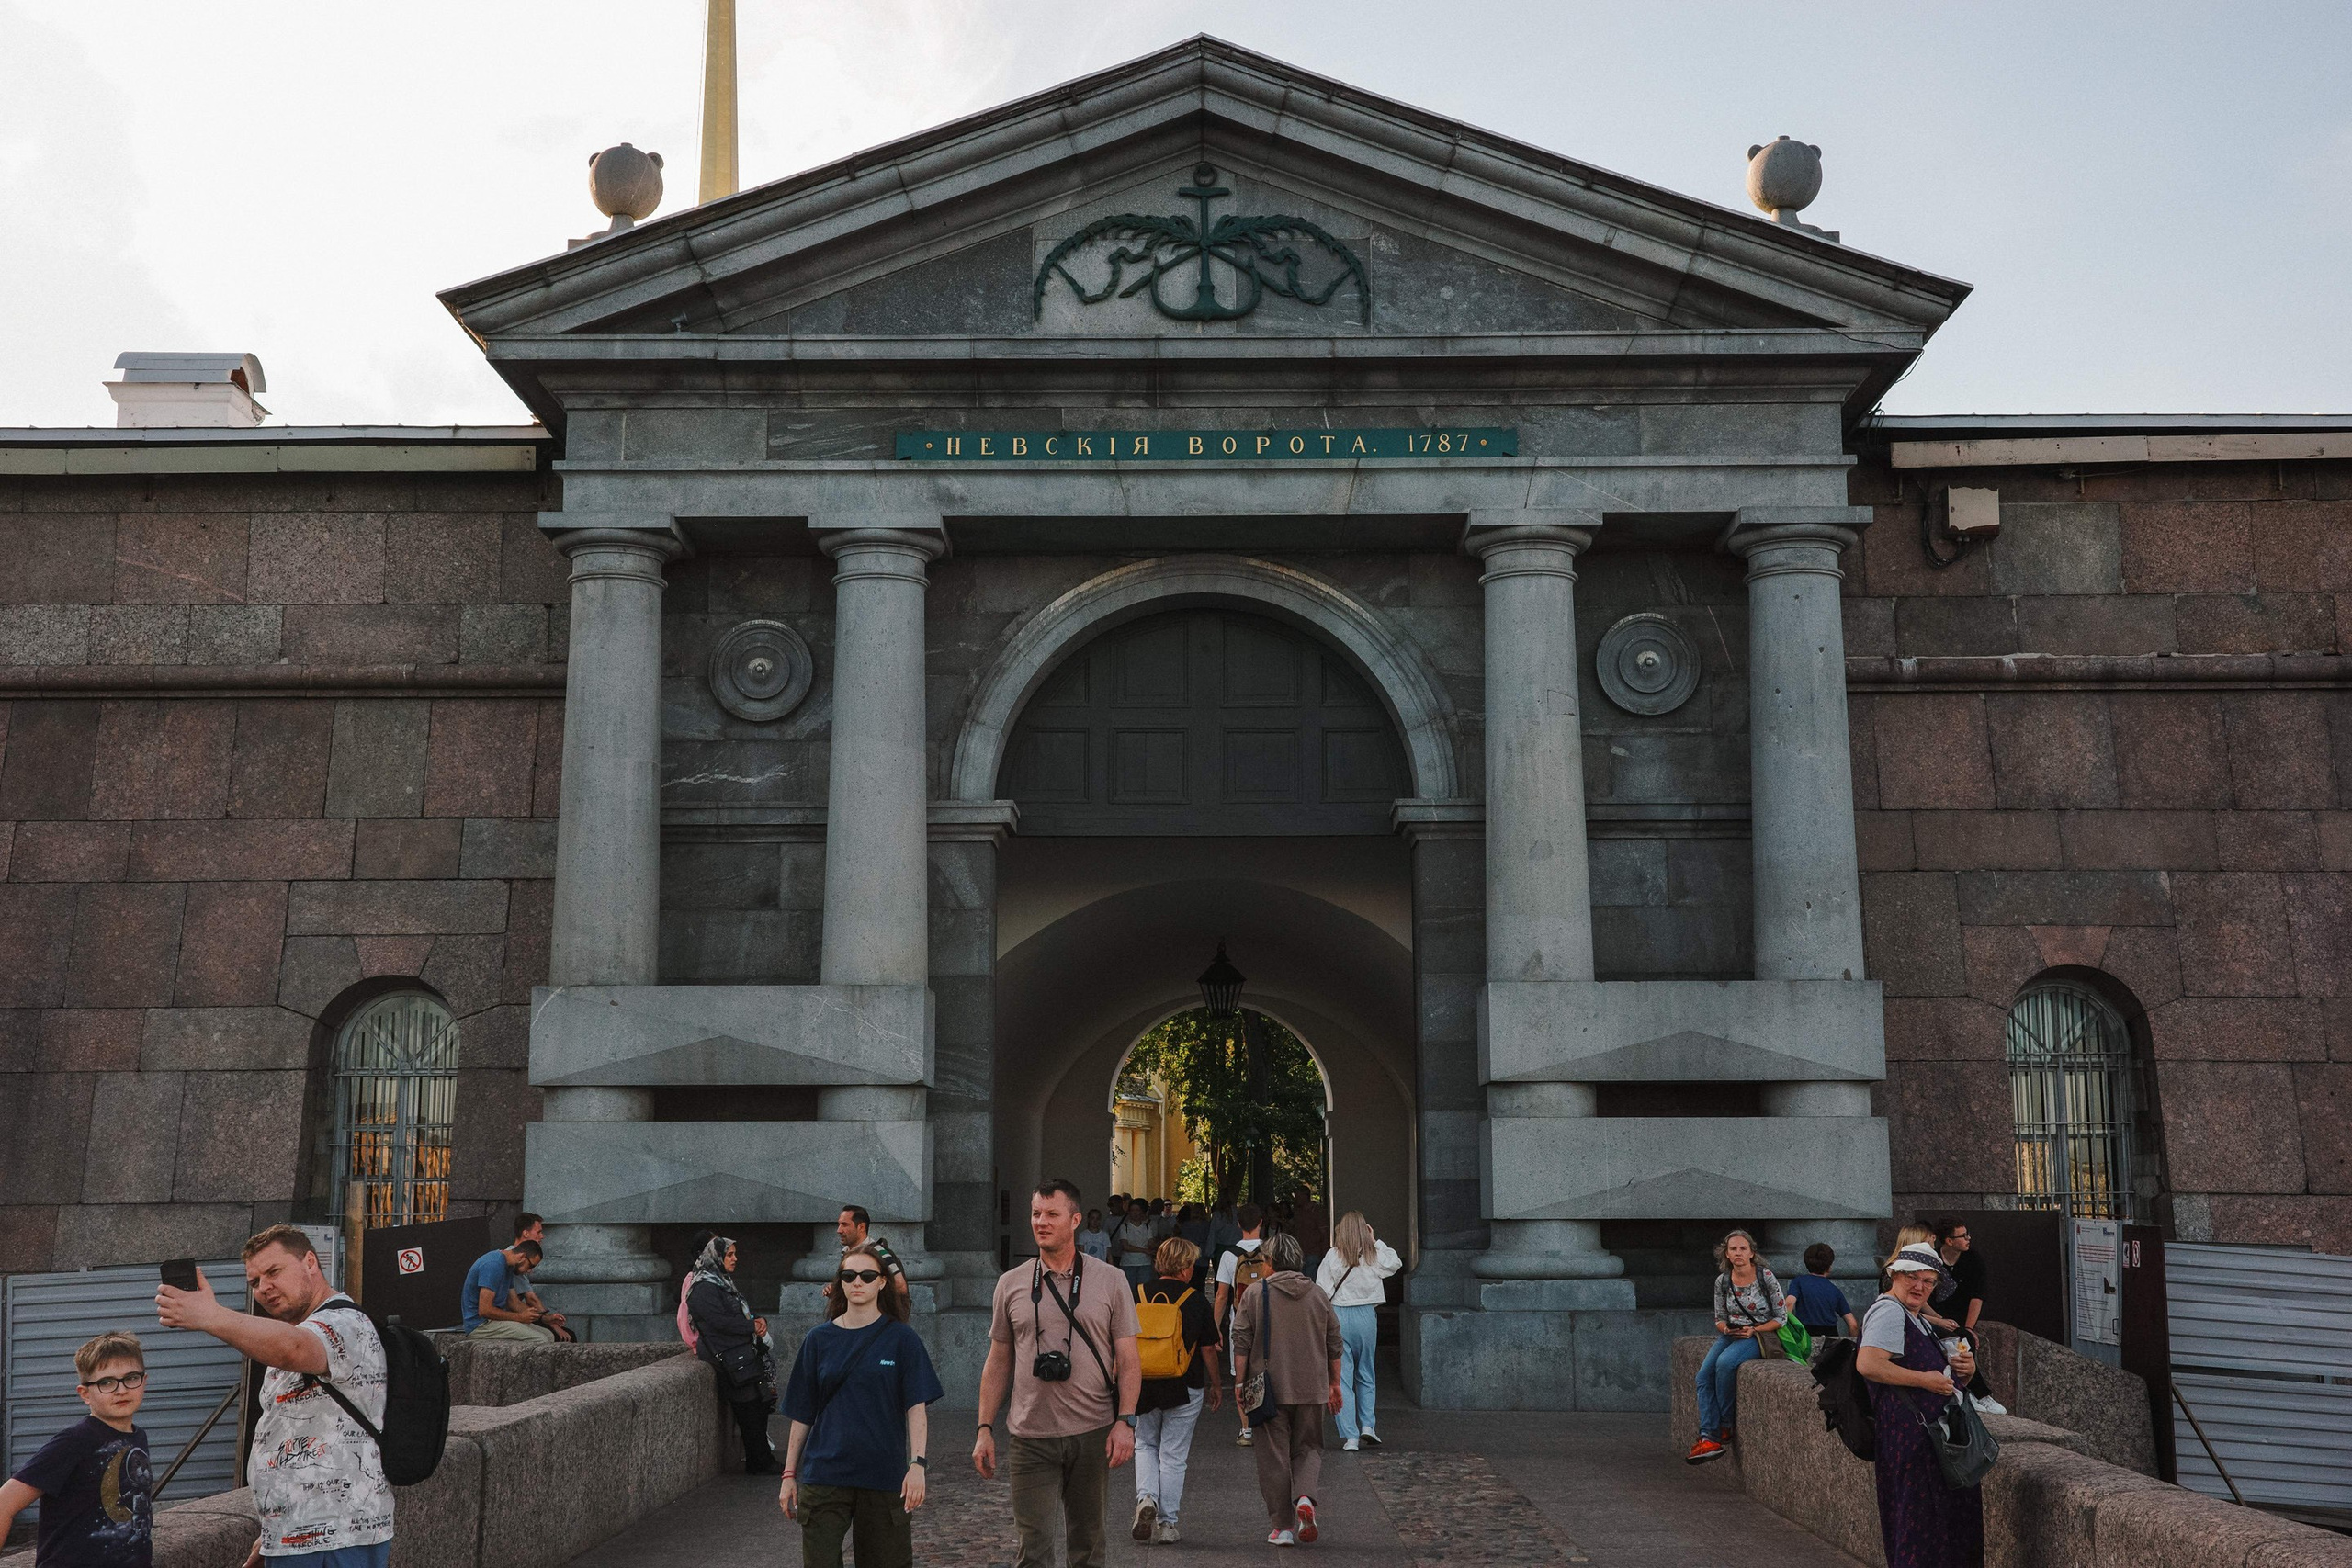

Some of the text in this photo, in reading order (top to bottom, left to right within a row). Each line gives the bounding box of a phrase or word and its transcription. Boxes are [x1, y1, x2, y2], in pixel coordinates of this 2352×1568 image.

[946, 434, 1469, 456] НЕВСКІЯ ВОРОТА. 1787
[1072, 1275, 1080, 1294] Canon
